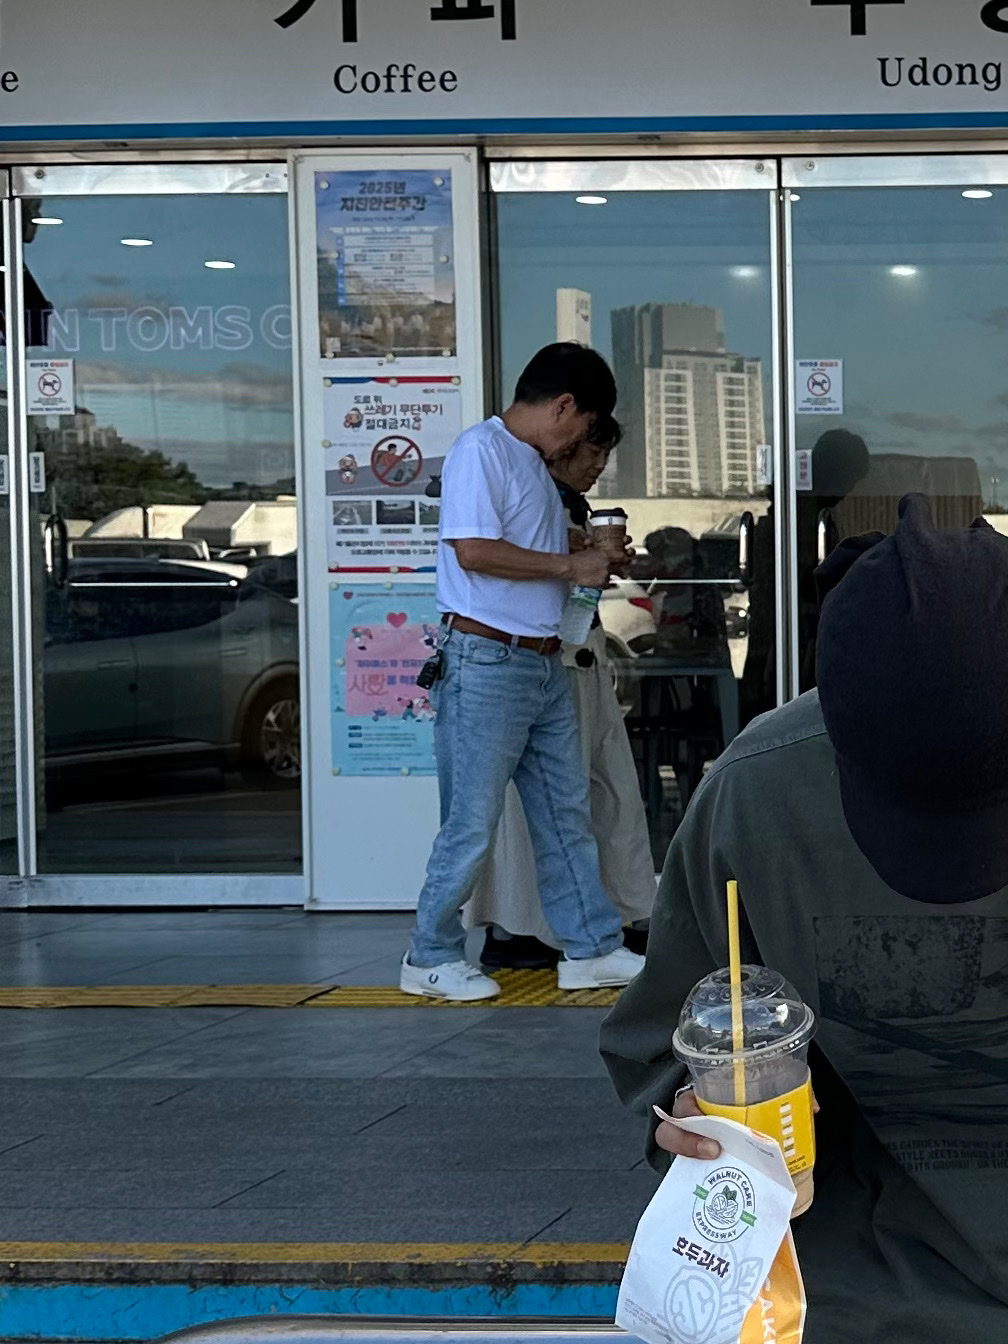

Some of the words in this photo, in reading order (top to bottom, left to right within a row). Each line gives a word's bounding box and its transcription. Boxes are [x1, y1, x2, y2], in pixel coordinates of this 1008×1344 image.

[333, 64, 459, 94] Coffee
[878, 57, 1002, 92] Udong
[358, 182, 406, 195] 2025년
[88, 304, 253, 351] TOMS
[354, 396, 371, 404] 도로
[364, 404, 397, 416] 쓰레기
[399, 403, 443, 416] 무단투기
[365, 417, 411, 431] 절대금지
[707, 1170, 743, 1186] WALNUT
[695, 1211, 738, 1239] EXPRESSWAY
[671, 1236, 731, 1279] 호두과자
